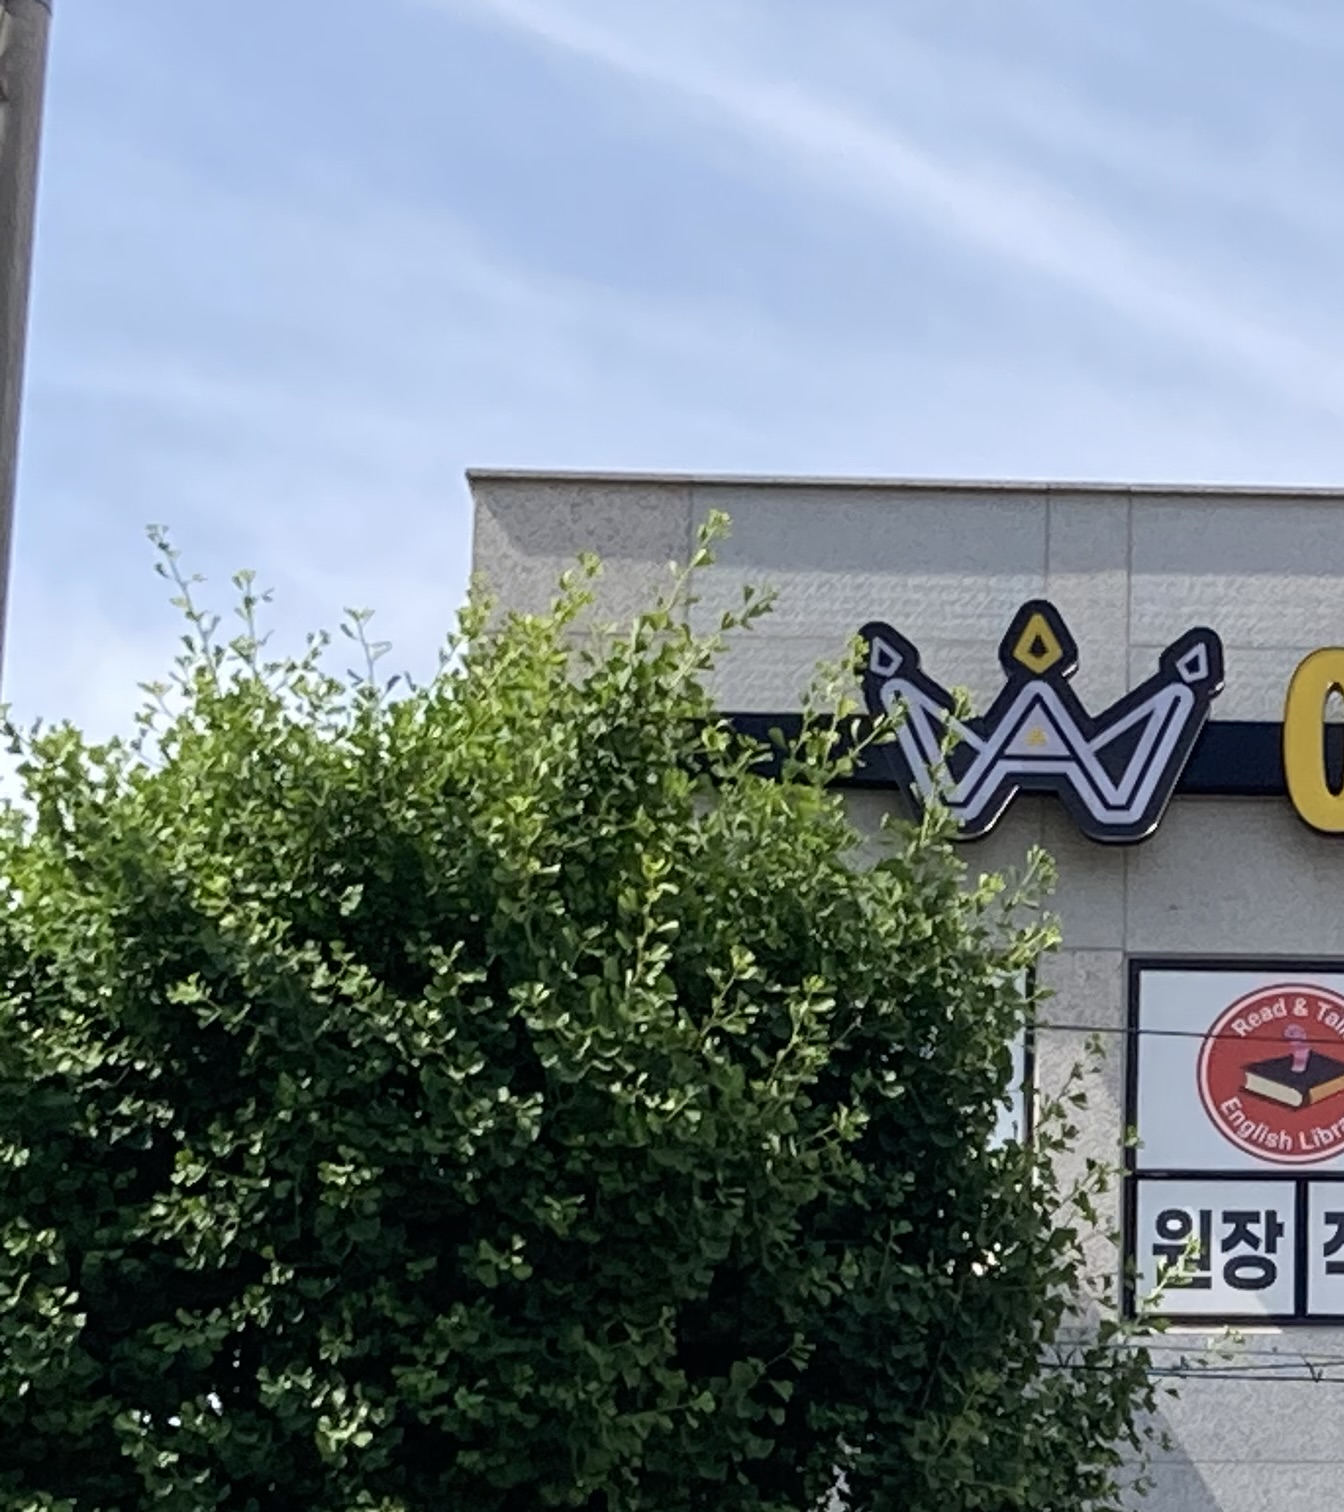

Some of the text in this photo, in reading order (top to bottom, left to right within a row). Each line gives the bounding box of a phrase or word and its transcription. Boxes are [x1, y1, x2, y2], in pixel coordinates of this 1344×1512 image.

[1231, 998, 1287, 1037] Read
[1293, 998, 1309, 1017] &
[1220, 1097, 1293, 1151] English
[1152, 1208, 1284, 1291] 원장
